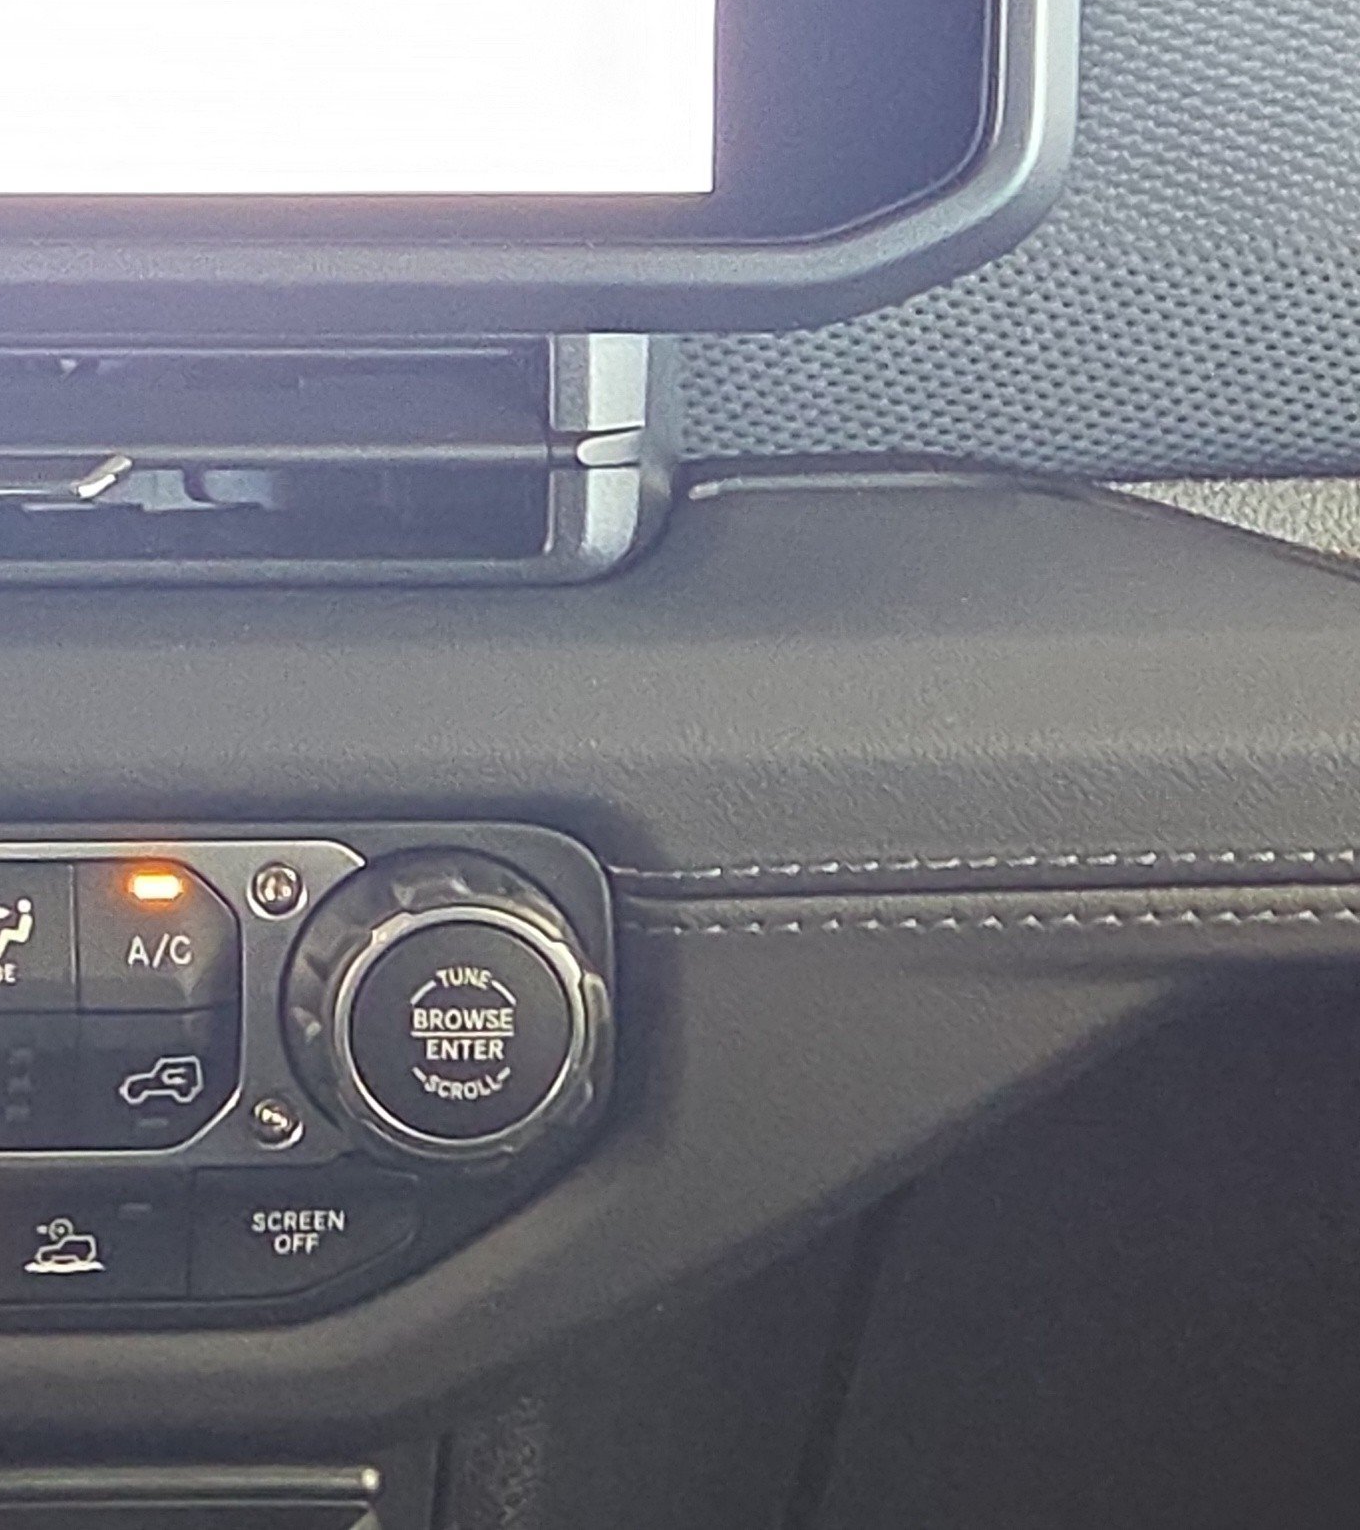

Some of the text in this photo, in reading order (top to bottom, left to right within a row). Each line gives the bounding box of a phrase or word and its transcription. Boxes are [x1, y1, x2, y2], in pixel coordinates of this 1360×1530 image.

[127, 935, 191, 967] A/C
[436, 968, 493, 990] TUNE
[412, 1007, 513, 1030] BROWSE
[426, 1037, 504, 1061] ENTER
[424, 1073, 501, 1099] SCROLL
[252, 1211, 344, 1233] SCREEN
[274, 1233, 318, 1255] OFF
